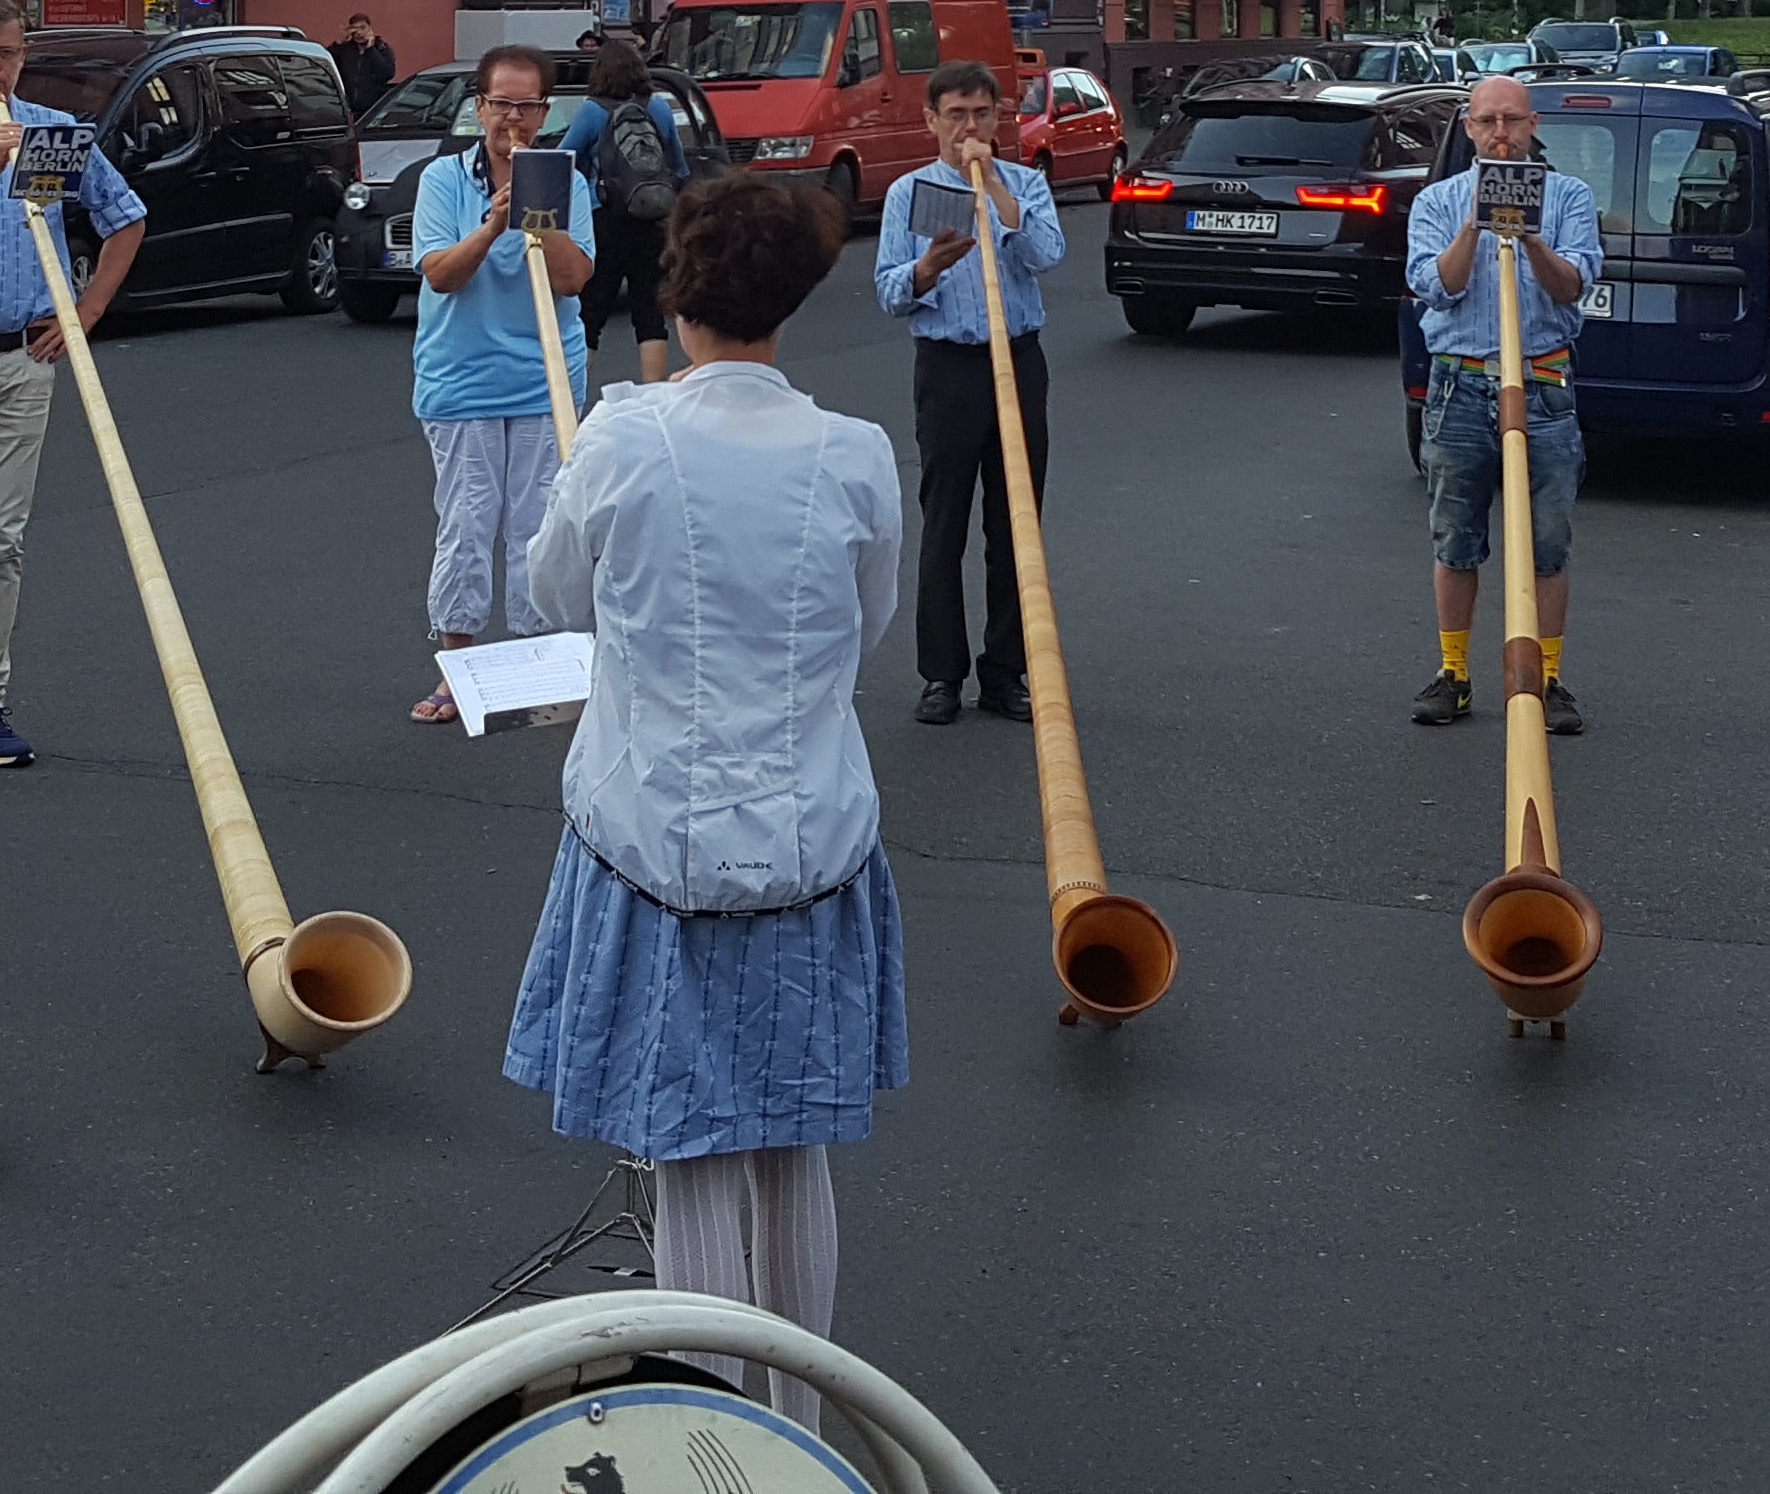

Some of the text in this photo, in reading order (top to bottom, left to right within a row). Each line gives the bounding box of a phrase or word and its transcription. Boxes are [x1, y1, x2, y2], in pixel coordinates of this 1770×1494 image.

[28, 128, 95, 150] ALP
[23, 149, 90, 162] HORN
[19, 161, 86, 173] BERLIN
[1481, 166, 1544, 184] ALP
[1480, 182, 1542, 196] HORN
[1479, 194, 1542, 207] BERLIN
[1195, 213, 1275, 230] M HK 1717
[735, 861, 773, 871] VAUDE
